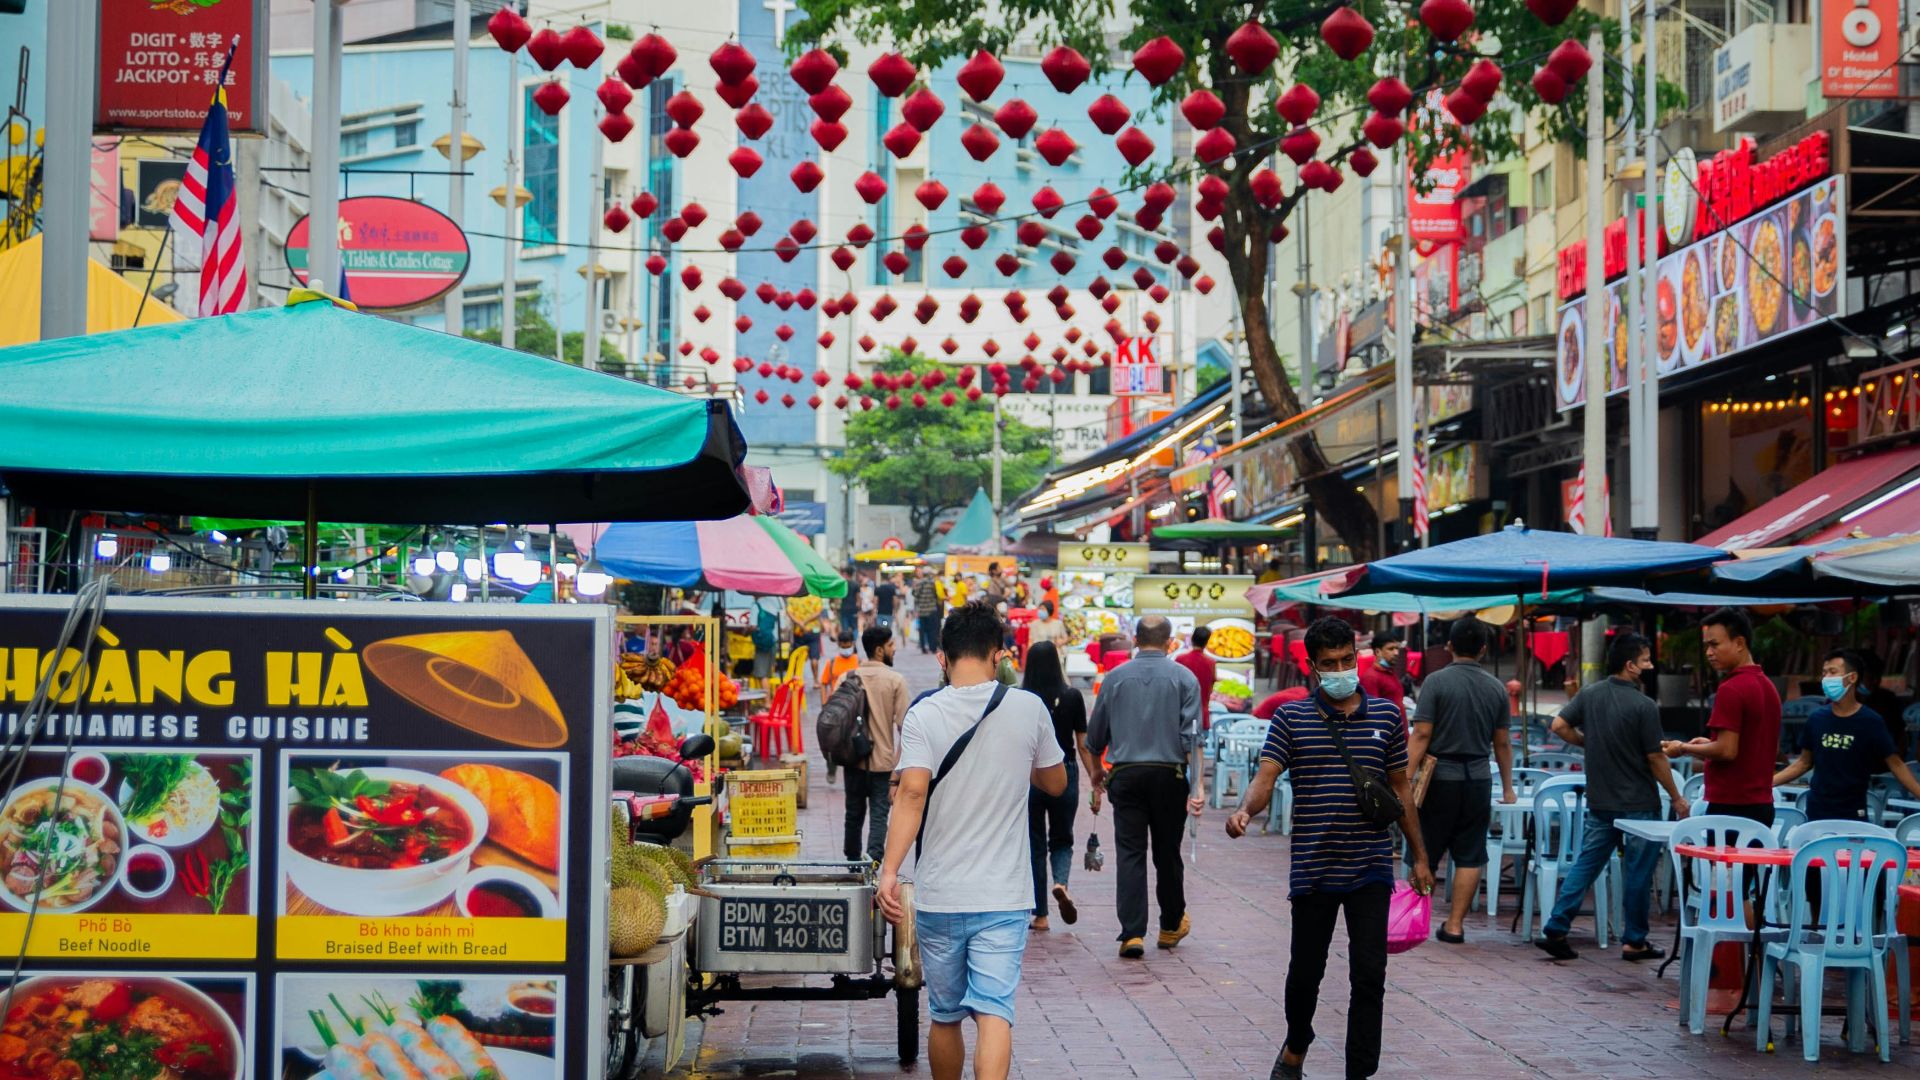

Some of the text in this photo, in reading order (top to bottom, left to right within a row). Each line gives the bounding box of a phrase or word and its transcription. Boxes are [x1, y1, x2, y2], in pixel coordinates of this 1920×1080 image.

[130, 32, 223, 48] DIGIT 数字
[126, 51, 226, 68] LOTTO 乐多
[1843, 51, 1878, 62] Hotel
[115, 68, 190, 83] JACKPOT
[108, 108, 243, 121] www.sportstoto.cmy
[1117, 337, 1155, 364] KK
[0, 625, 369, 706] HOÀNG HÀ
[0, 713, 369, 740] IETNAMESE CUISINE
[724, 902, 843, 925] BDM 250 KG
[113, 918, 132, 933] Bò
[359, 922, 475, 937] Bò kho bánh mì
[723, 925, 843, 948] BTM 140 KG
[59, 938, 151, 952] Beef Noodle
[326, 940, 507, 955] Braised Beef with Bread
